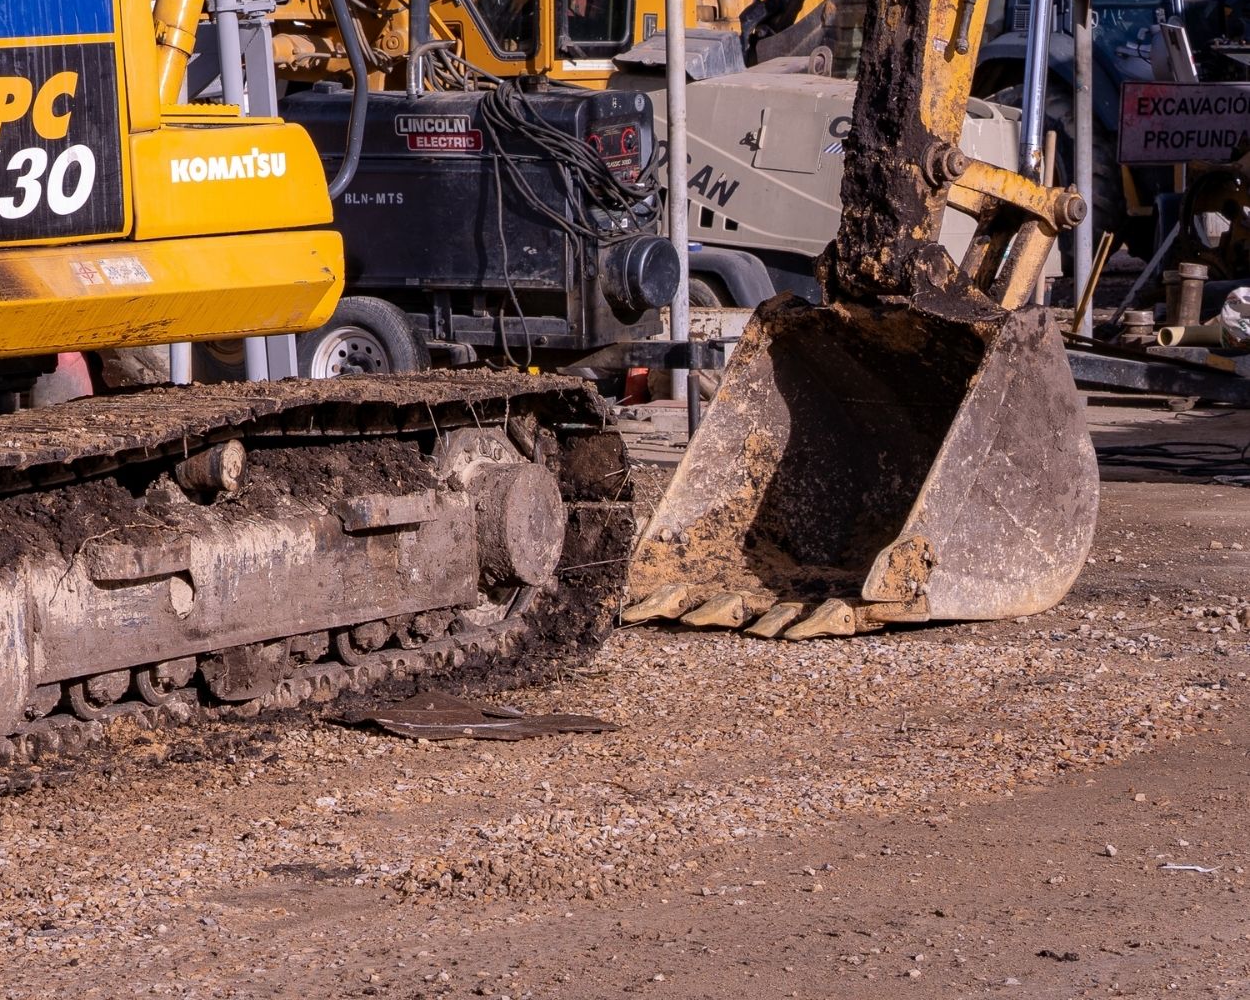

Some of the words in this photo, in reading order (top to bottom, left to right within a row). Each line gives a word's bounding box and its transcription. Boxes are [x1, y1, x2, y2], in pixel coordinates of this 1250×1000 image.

[1136, 92, 1250, 117] EXCAVACIÓ
[399, 118, 466, 133] LINCOLN
[416, 136, 475, 148] ELECTRIC
[170, 147, 286, 183] KOMATSU
[344, 193, 404, 205] BLN-MTS
